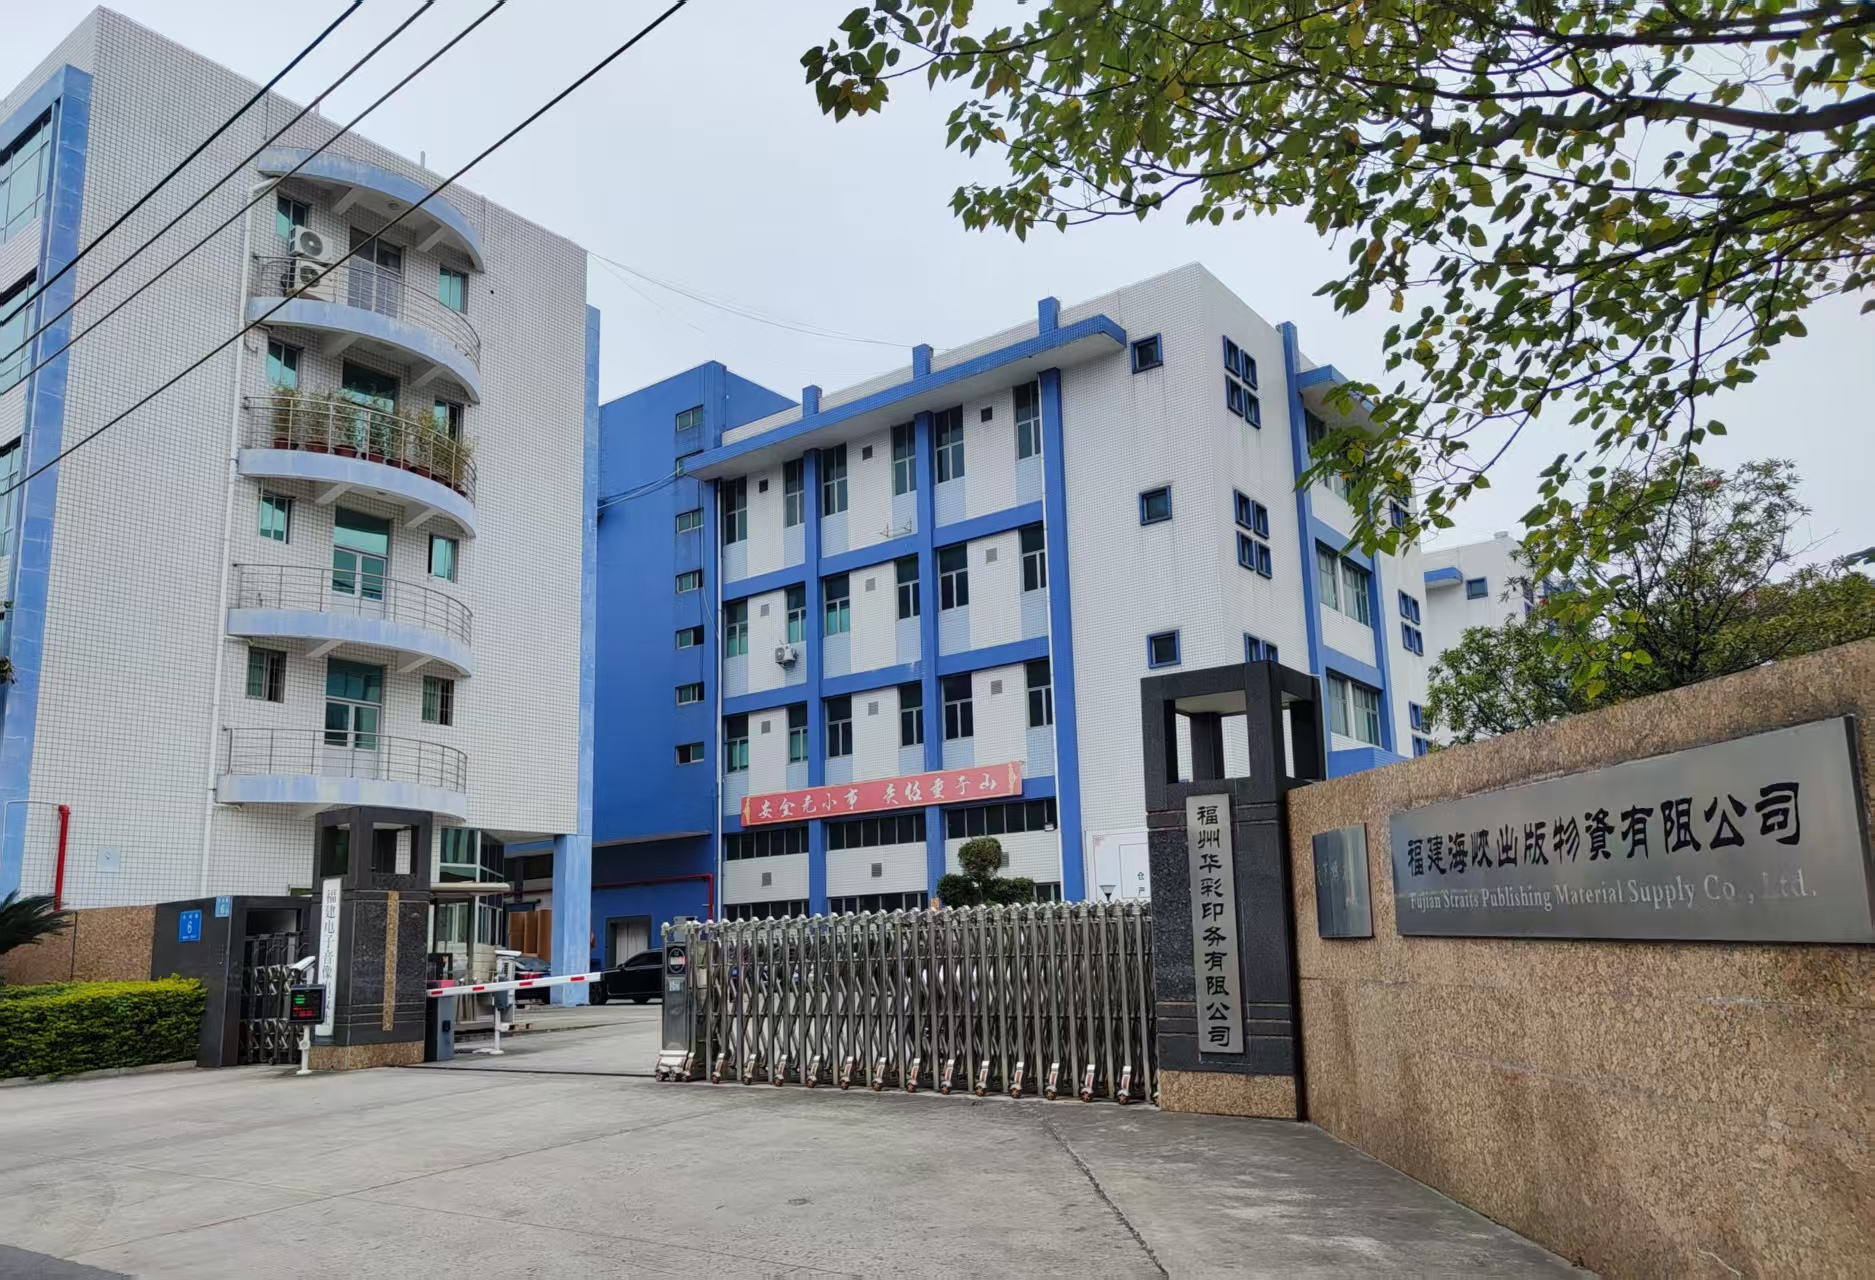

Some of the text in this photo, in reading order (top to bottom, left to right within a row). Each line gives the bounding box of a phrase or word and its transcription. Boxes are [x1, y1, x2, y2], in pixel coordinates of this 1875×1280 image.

[758, 788, 859, 819] 安全无小事
[1409, 891, 1441, 912] Fujian
[1442, 888, 1479, 908] Straits
[1481, 885, 1553, 911] Publishing
[1554, 879, 1624, 905] Material
[1627, 874, 1695, 909] Supply
[186, 920, 193, 934] 6
[1196, 805, 1231, 1047] 福州华彩印务有限公司
